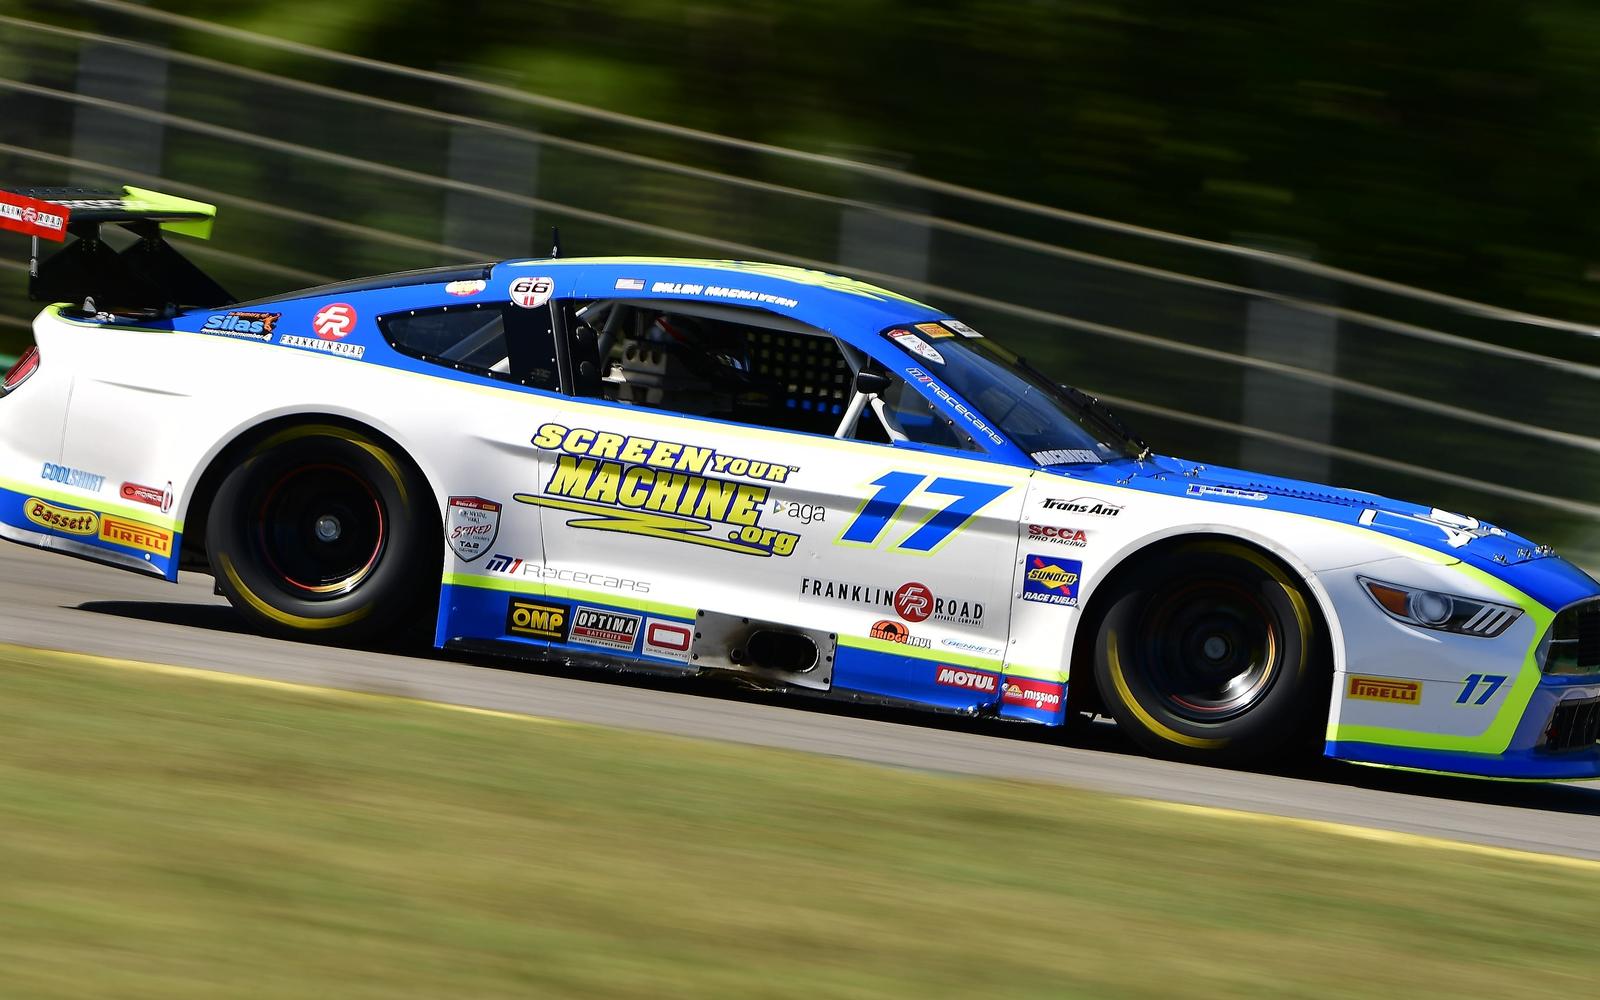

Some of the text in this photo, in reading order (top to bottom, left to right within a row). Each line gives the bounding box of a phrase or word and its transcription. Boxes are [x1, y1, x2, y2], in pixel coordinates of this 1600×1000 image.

[514, 282, 550, 293] 66
[204, 315, 264, 333] Silas
[281, 335, 364, 356] FRANKLIN ROAD
[531, 423, 716, 474] SCREEN
[544, 454, 771, 526] MACHINE
[32, 503, 93, 531] Bassett
[788, 501, 827, 525] aga
[840, 470, 1014, 552] 17
[1043, 498, 1088, 513] Trans
[1088, 504, 1119, 516] Am
[104, 519, 169, 551] PIRELLI
[460, 540, 479, 548] TA2
[728, 526, 801, 557] .org
[1028, 524, 1087, 542] SCCA
[1050, 538, 1087, 548] RACING
[1030, 570, 1076, 584] SUNOCO
[801, 577, 894, 606] FRANKLIN
[1024, 592, 1077, 606] RACE FUELS
[513, 607, 564, 631] OMP
[934, 597, 984, 620] ROAD
[578, 612, 633, 634] OPTIMA
[958, 618, 981, 626] COMPANY
[586, 630, 621, 640] BATTERIES
[938, 668, 995, 691] MOTUL
[1351, 678, 1417, 701] PIRELLI
[1455, 674, 1507, 705] 17
